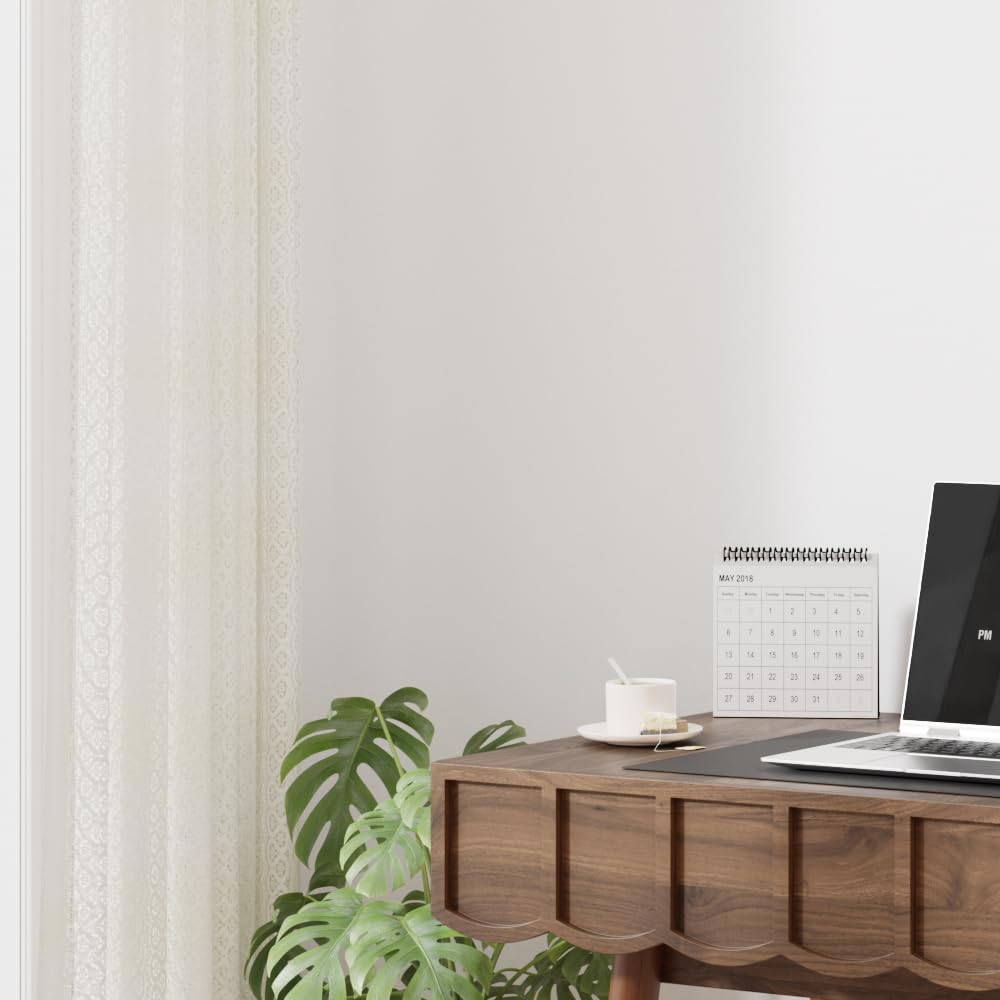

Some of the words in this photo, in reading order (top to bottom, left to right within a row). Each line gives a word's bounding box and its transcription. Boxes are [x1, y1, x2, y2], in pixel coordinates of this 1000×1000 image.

[718, 574, 735, 583] MAY
[736, 575, 753, 583] 2018
[978, 630, 992, 640] PM
